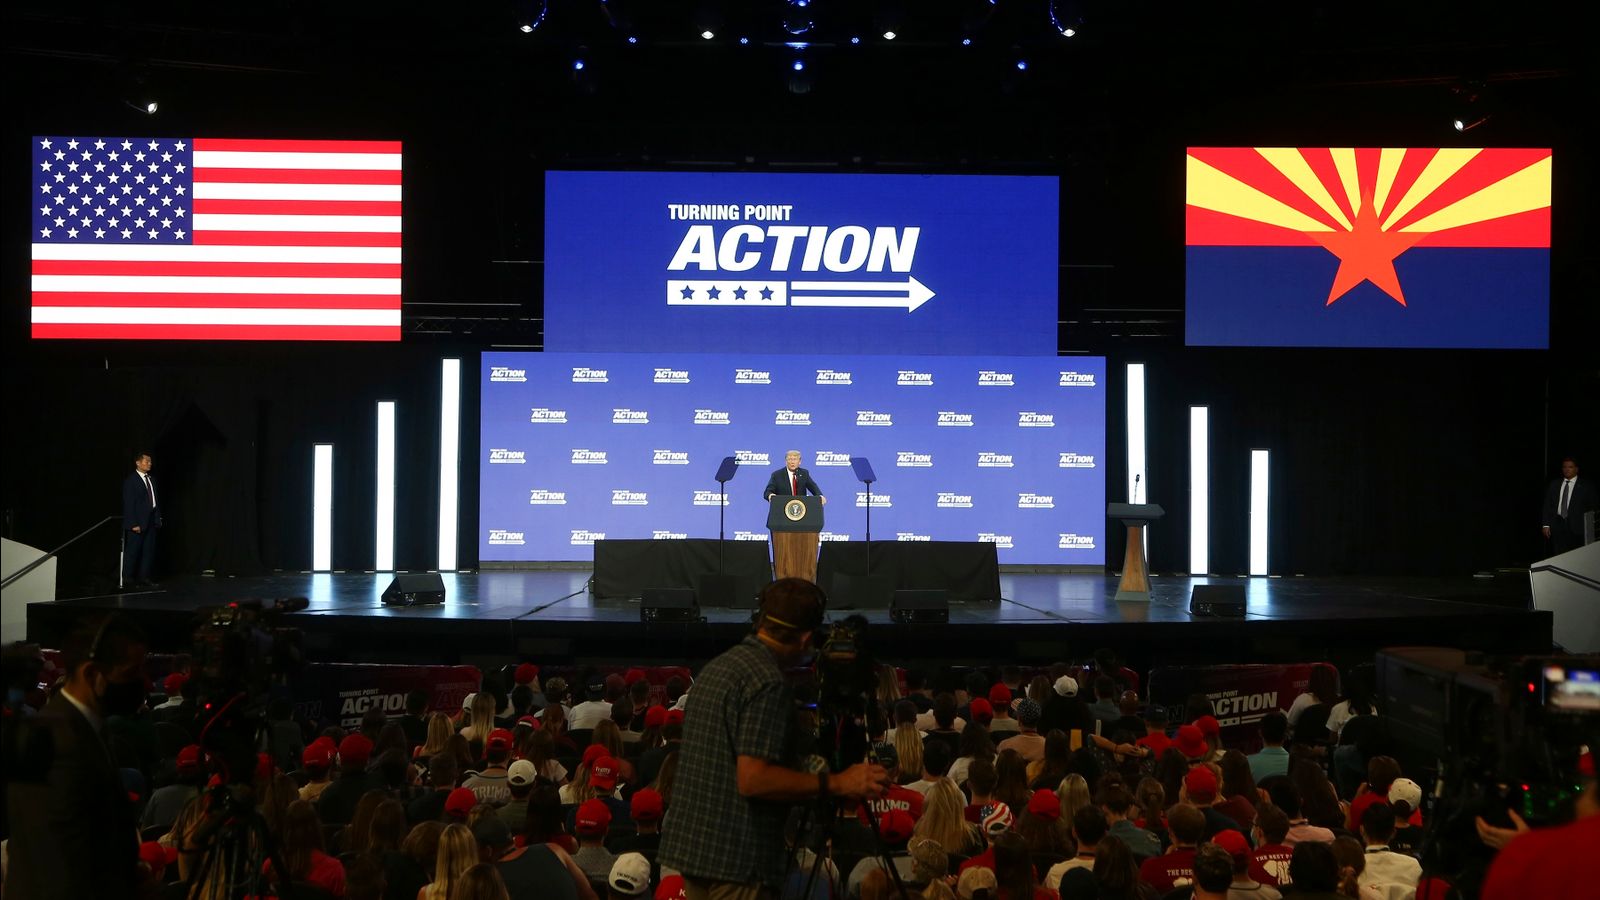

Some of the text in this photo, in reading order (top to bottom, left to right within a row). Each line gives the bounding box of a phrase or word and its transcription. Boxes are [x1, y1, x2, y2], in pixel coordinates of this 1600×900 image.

[668, 204, 793, 221] TURNING POINT
[666, 224, 921, 272] ACTION
[491, 369, 526, 377] ACTION
[573, 370, 608, 378] ACTION
[654, 371, 689, 379] ACTION
[735, 371, 770, 379] ACTION
[816, 372, 851, 380] ACTION
[897, 373, 932, 381] ACTION
[979, 373, 1014, 381] ACTION
[1060, 374, 1095, 382] ACTION
[531, 410, 566, 418] ACTION
[613, 411, 648, 419] ACTION
[694, 412, 729, 420] ACTION
[776, 412, 811, 420] ACTION
[857, 413, 892, 421] ACTION
[938, 414, 973, 422] ACTION
[1019, 414, 1054, 422] ACTION
[490, 451, 525, 459] ACTION
[572, 451, 607, 459] ACTION
[653, 452, 688, 460] ACTION
[735, 453, 770, 461] ACTION
[816, 453, 851, 461] ACTION
[897, 454, 932, 462] ACTION
[978, 455, 1013, 463] ACTION
[1059, 455, 1094, 463] ACTION
[530, 492, 565, 500] ACTION
[612, 492, 647, 500] ACTION
[694, 493, 729, 501] ACTION
[856, 494, 891, 502] ACTION
[937, 495, 972, 503] ACTION
[1018, 495, 1053, 503] ACTION
[489, 532, 524, 540] ACTION
[571, 532, 606, 540] ACTION
[978, 535, 1013, 543] ACTION
[1059, 536, 1094, 544] ACTION
[472, 785, 511, 801] TRUMP
[1166, 868, 1193, 876] THE BES
